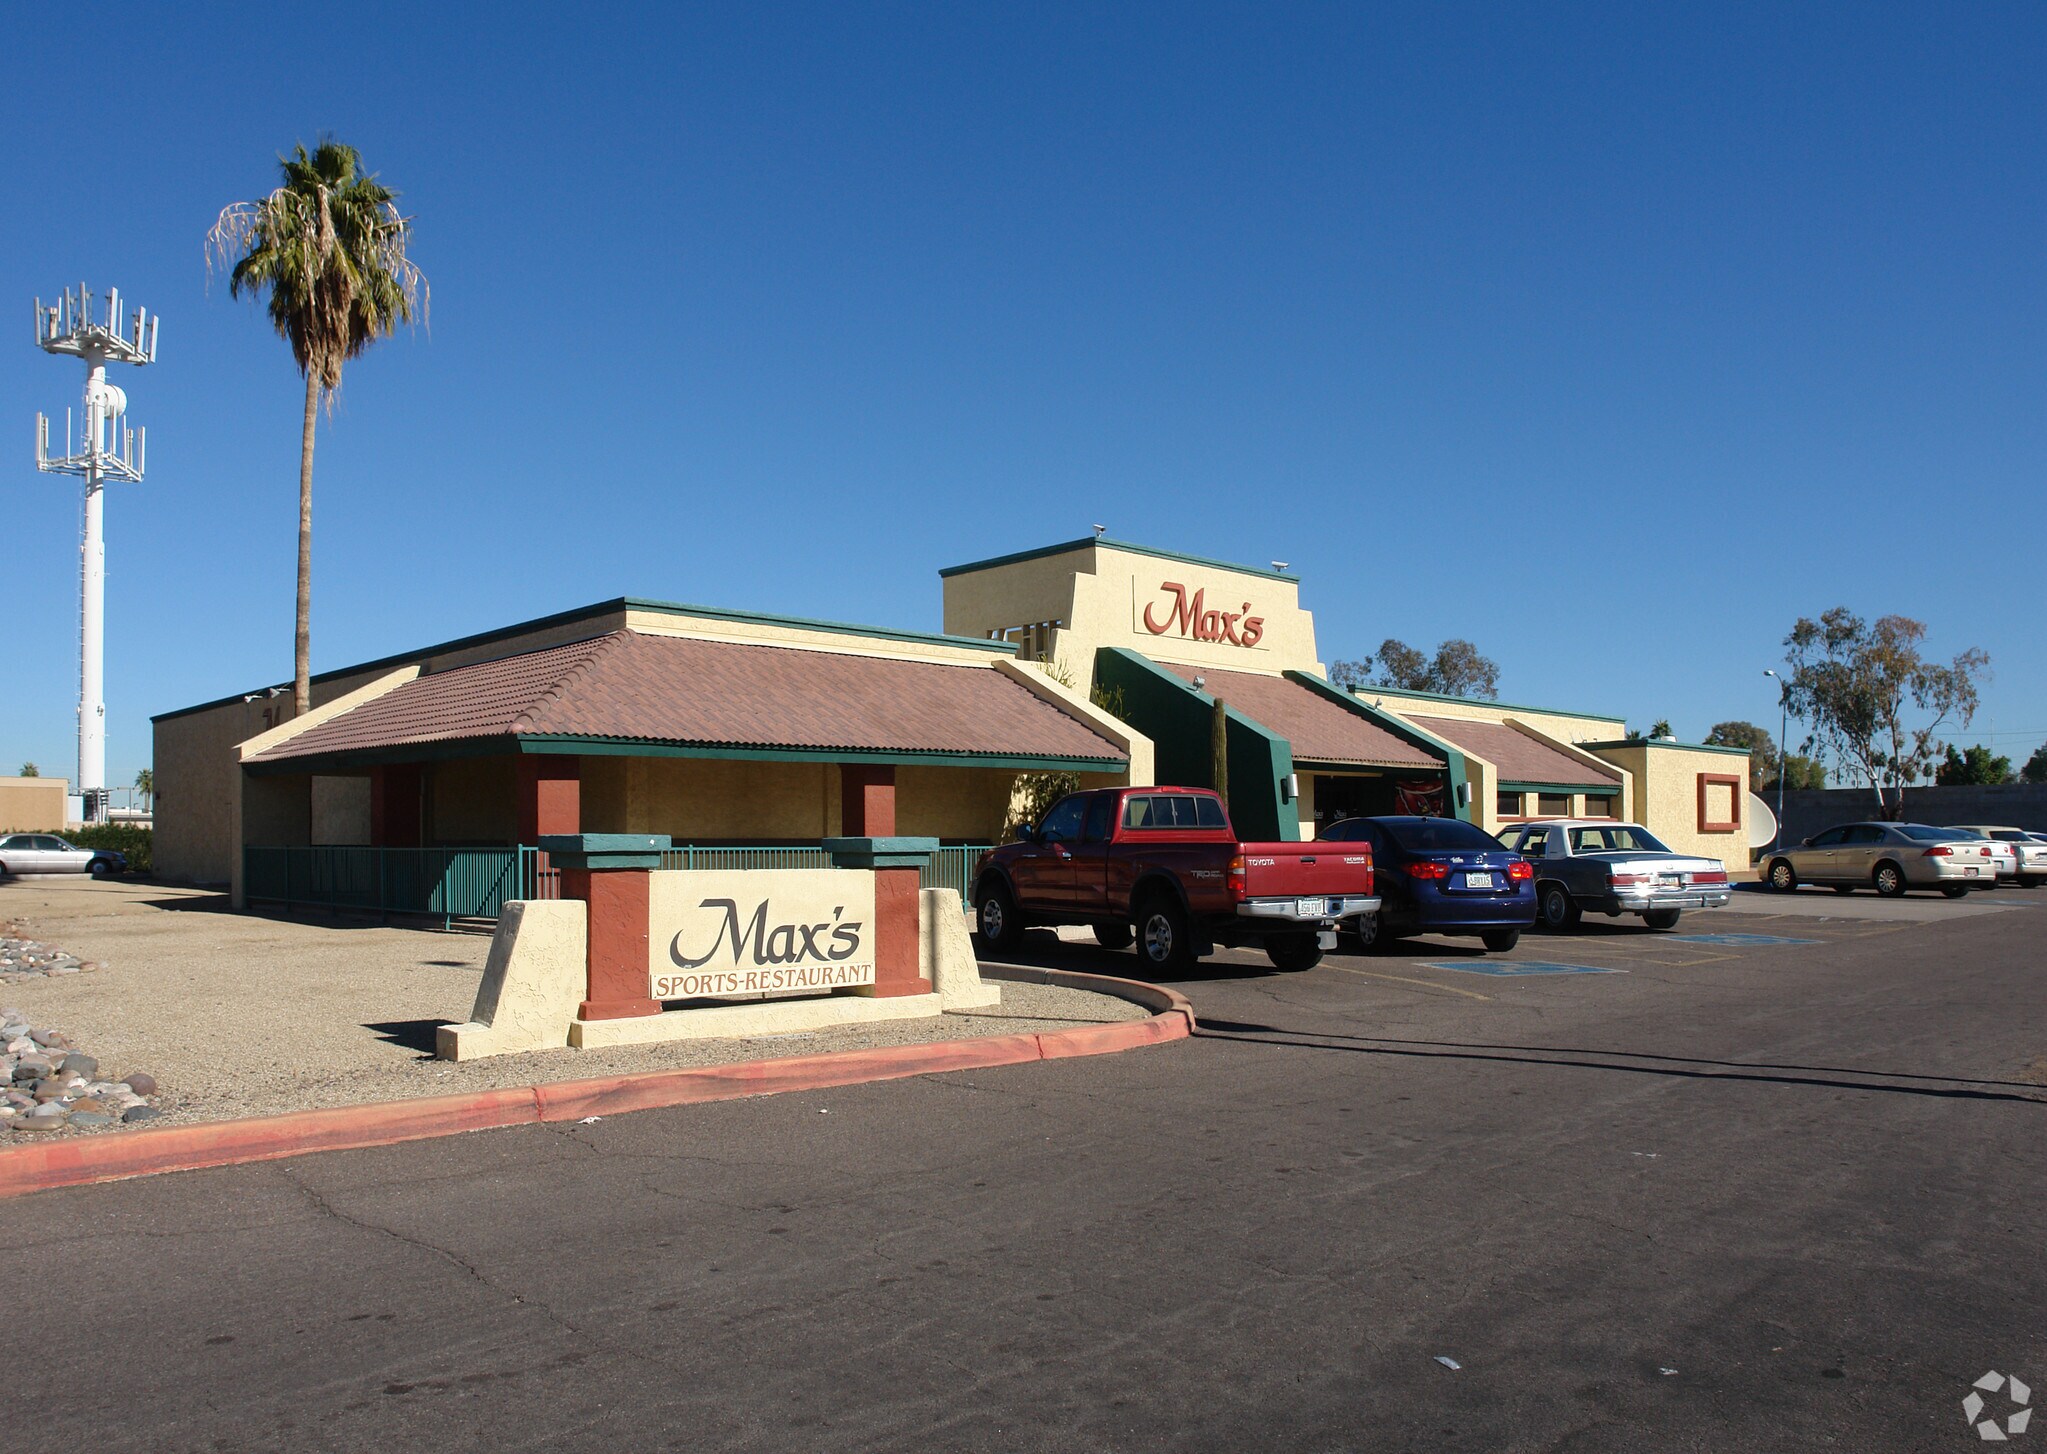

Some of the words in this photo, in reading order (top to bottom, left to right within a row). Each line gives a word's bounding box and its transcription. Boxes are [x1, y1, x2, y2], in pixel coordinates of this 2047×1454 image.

[1143, 581, 1265, 648] Max's
[669, 898, 863, 969] Max's
[655, 964, 871, 997] SPORTS-RESTAURANT
